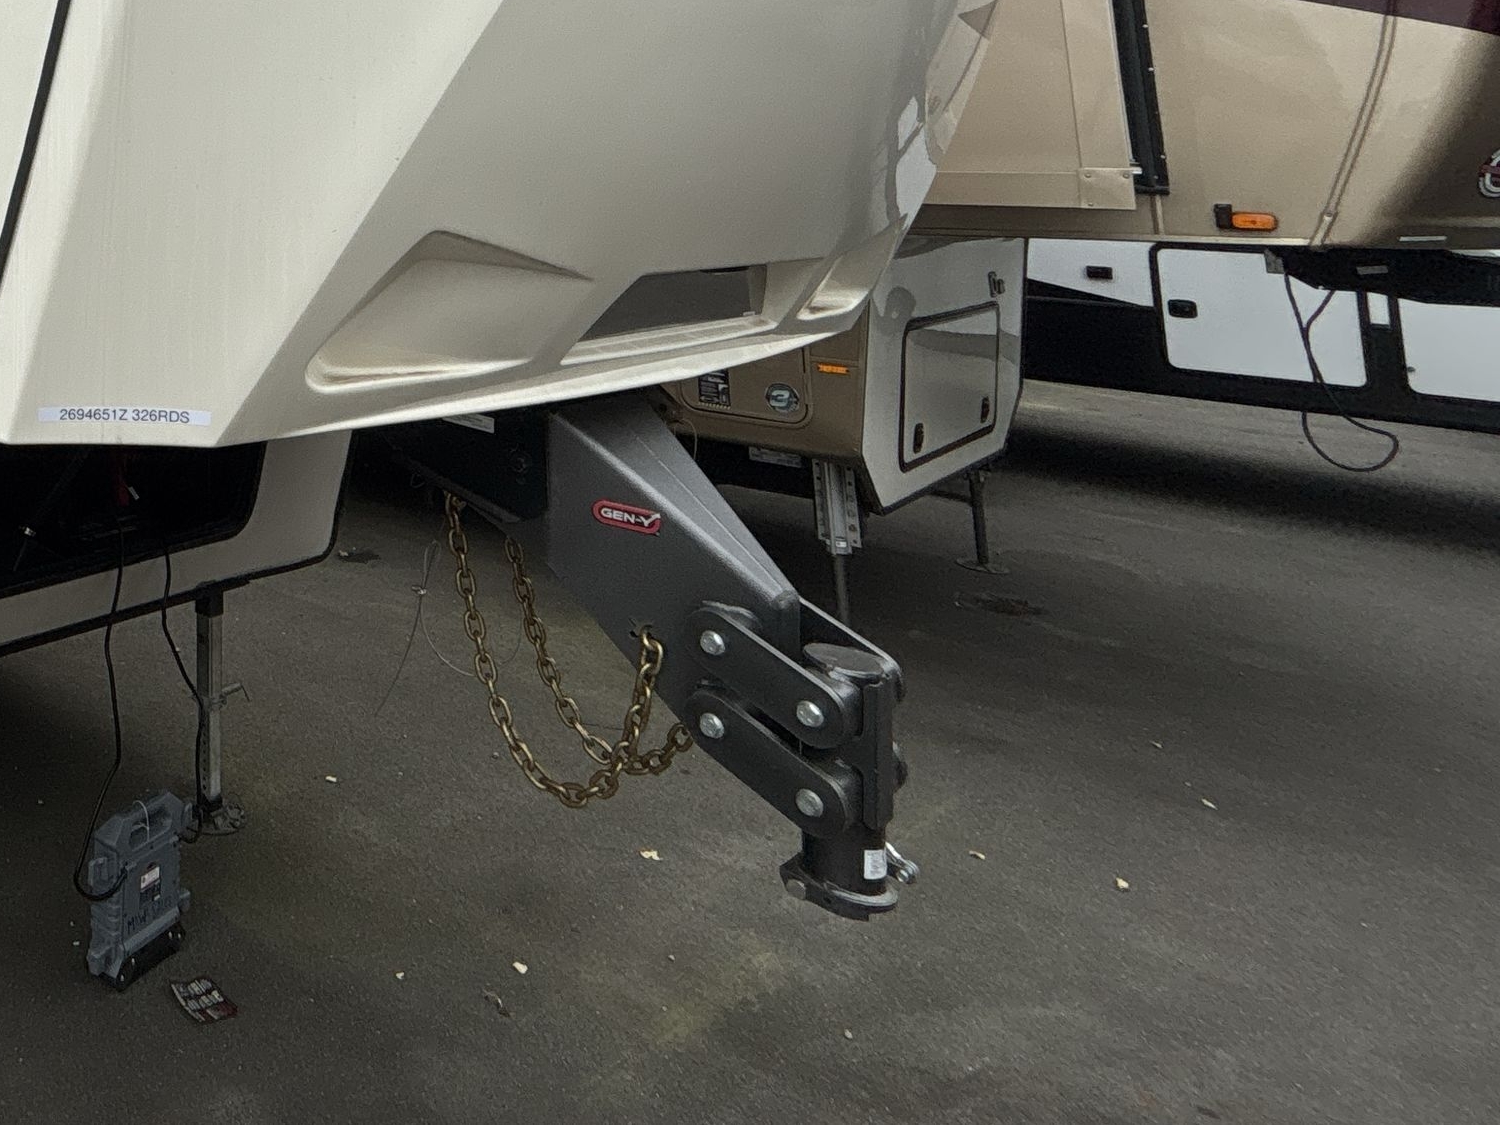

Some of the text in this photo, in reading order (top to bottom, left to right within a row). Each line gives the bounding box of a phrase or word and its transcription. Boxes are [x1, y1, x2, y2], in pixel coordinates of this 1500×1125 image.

[59, 408, 190, 423] 2694651Z 326RDS
[600, 506, 661, 527] GEN-Y
